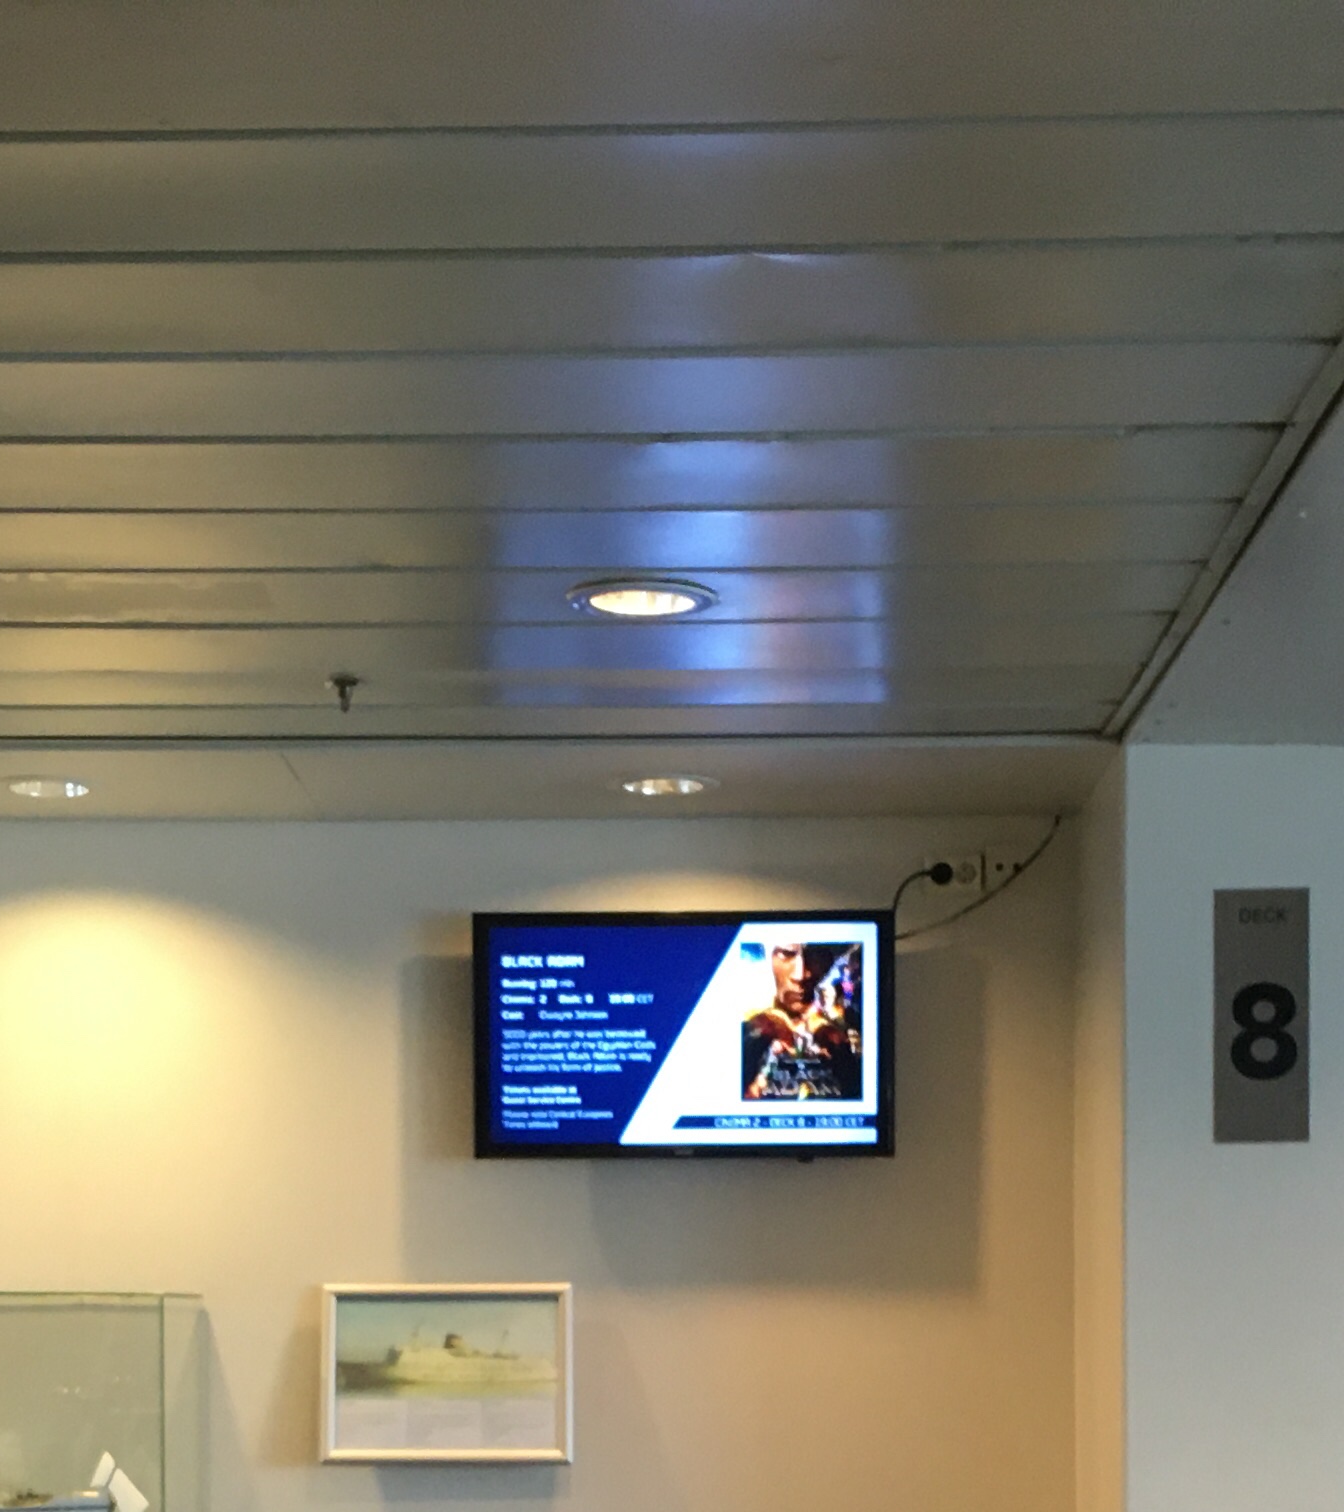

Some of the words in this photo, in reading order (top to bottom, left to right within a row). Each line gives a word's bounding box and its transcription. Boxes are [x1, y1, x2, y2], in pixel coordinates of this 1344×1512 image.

[1238, 907, 1288, 924] DECK
[501, 955, 543, 968] BLACK
[546, 955, 585, 968] ADAM
[539, 994, 547, 1004] 2
[1230, 981, 1298, 1081] 8
[715, 1117, 751, 1128] CINEMA
[770, 1117, 794, 1128] DECK
